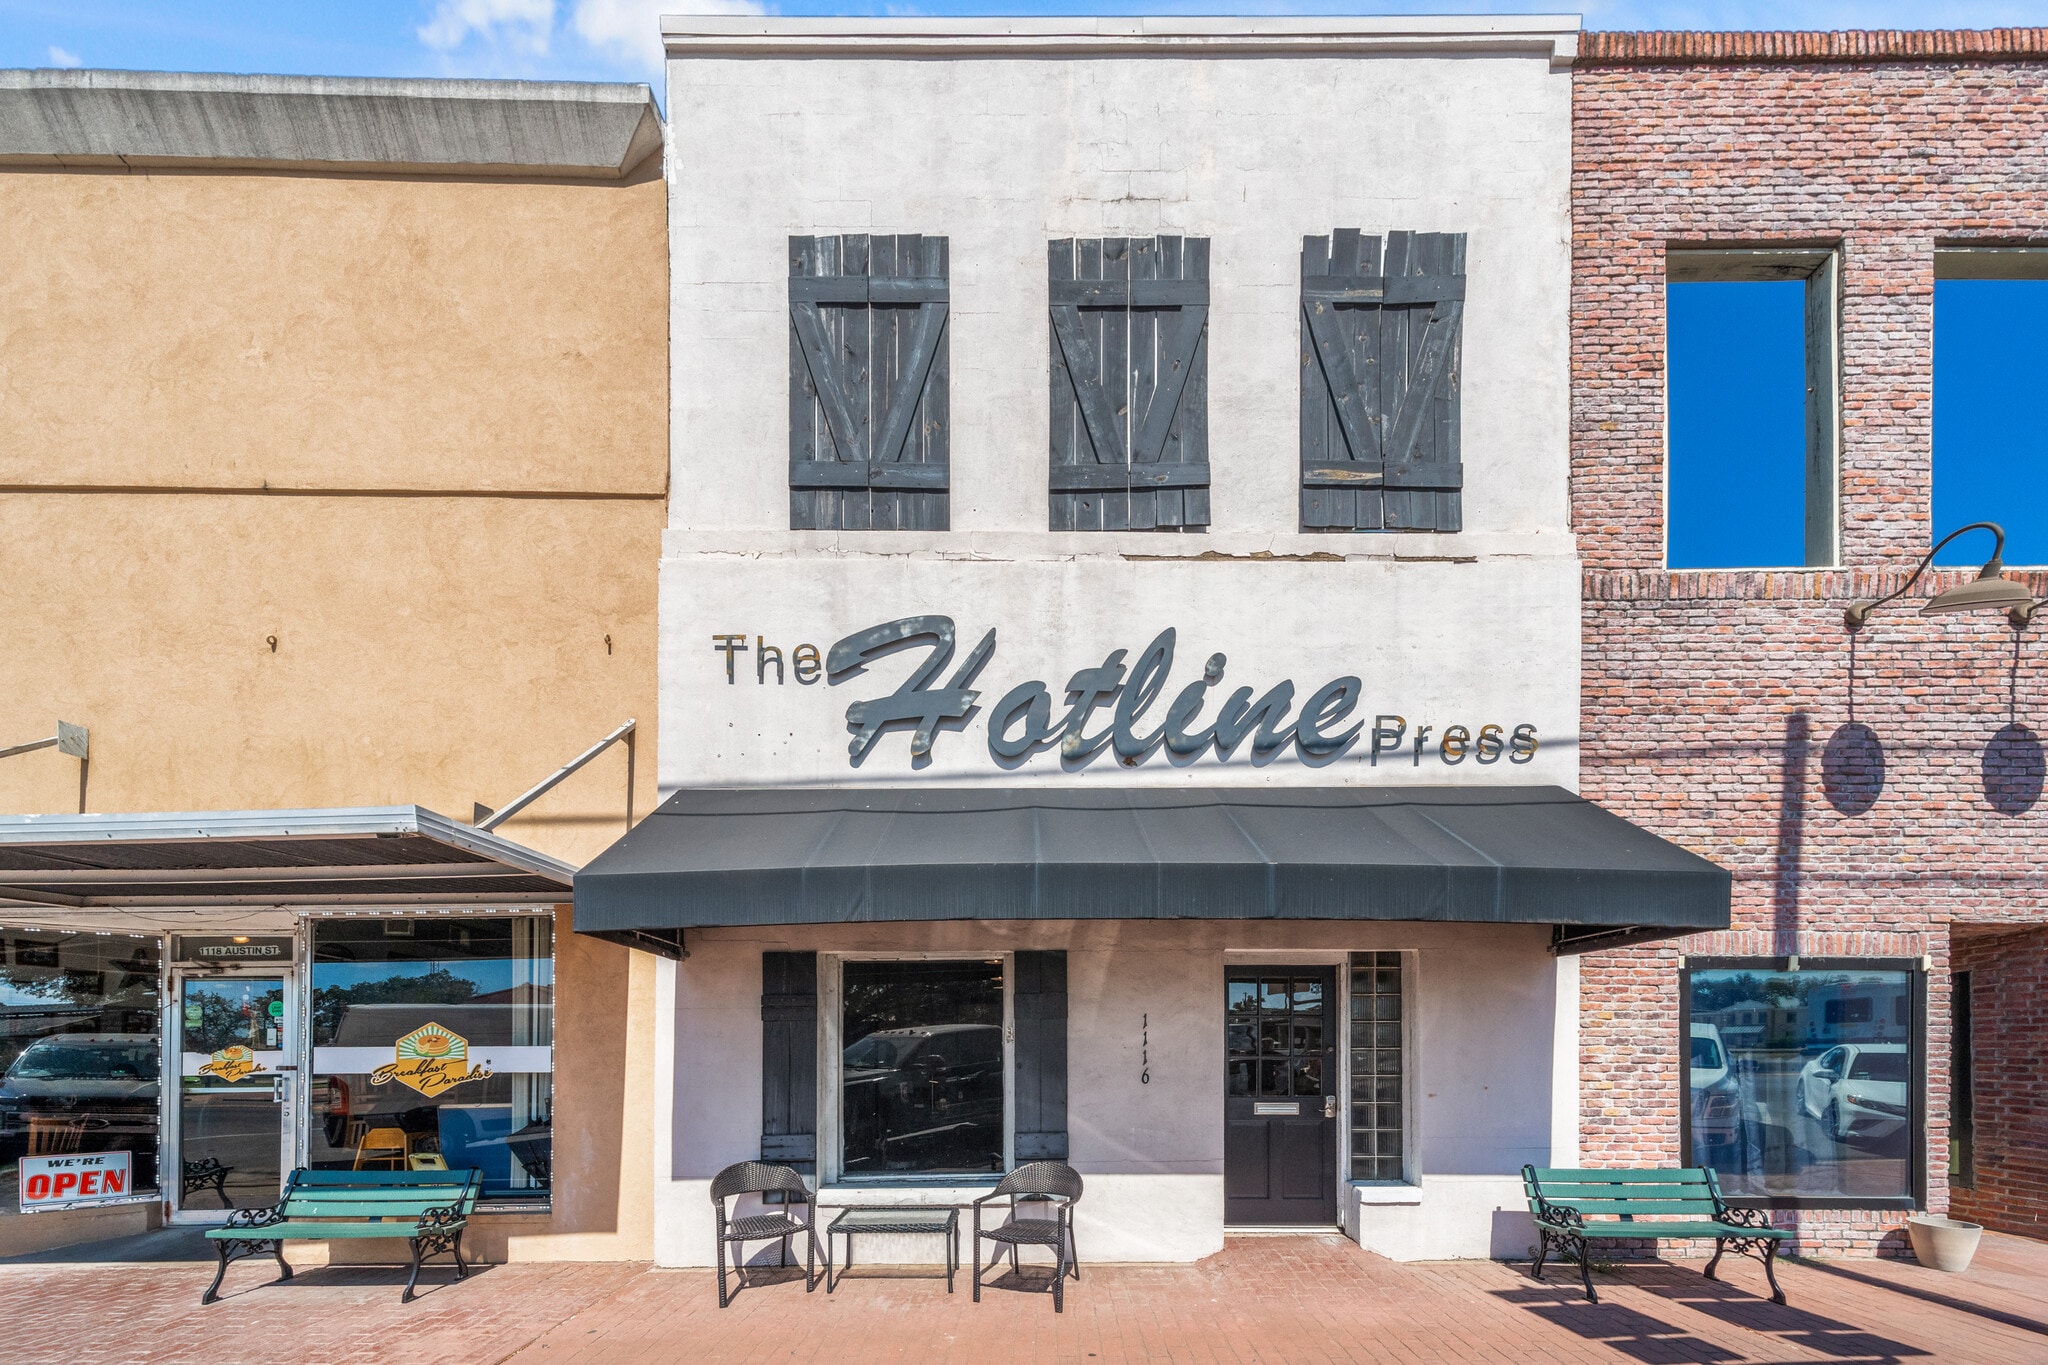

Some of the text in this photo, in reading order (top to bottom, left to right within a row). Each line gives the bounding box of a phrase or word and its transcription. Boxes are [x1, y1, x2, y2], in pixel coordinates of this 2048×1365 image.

[712, 615, 1539, 766] The Hotline Press
[200, 947, 222, 955] 1118
[224, 946, 262, 955] AUSTIN
[1141, 1013, 1150, 1085] 1116
[199, 1060, 253, 1075] Breakfast
[225, 1063, 267, 1078] Paradise
[372, 1058, 468, 1084] Breakfast
[418, 1063, 493, 1091] Paradise
[47, 1157, 105, 1168] WE'RE
[26, 1168, 126, 1200] OPEN
